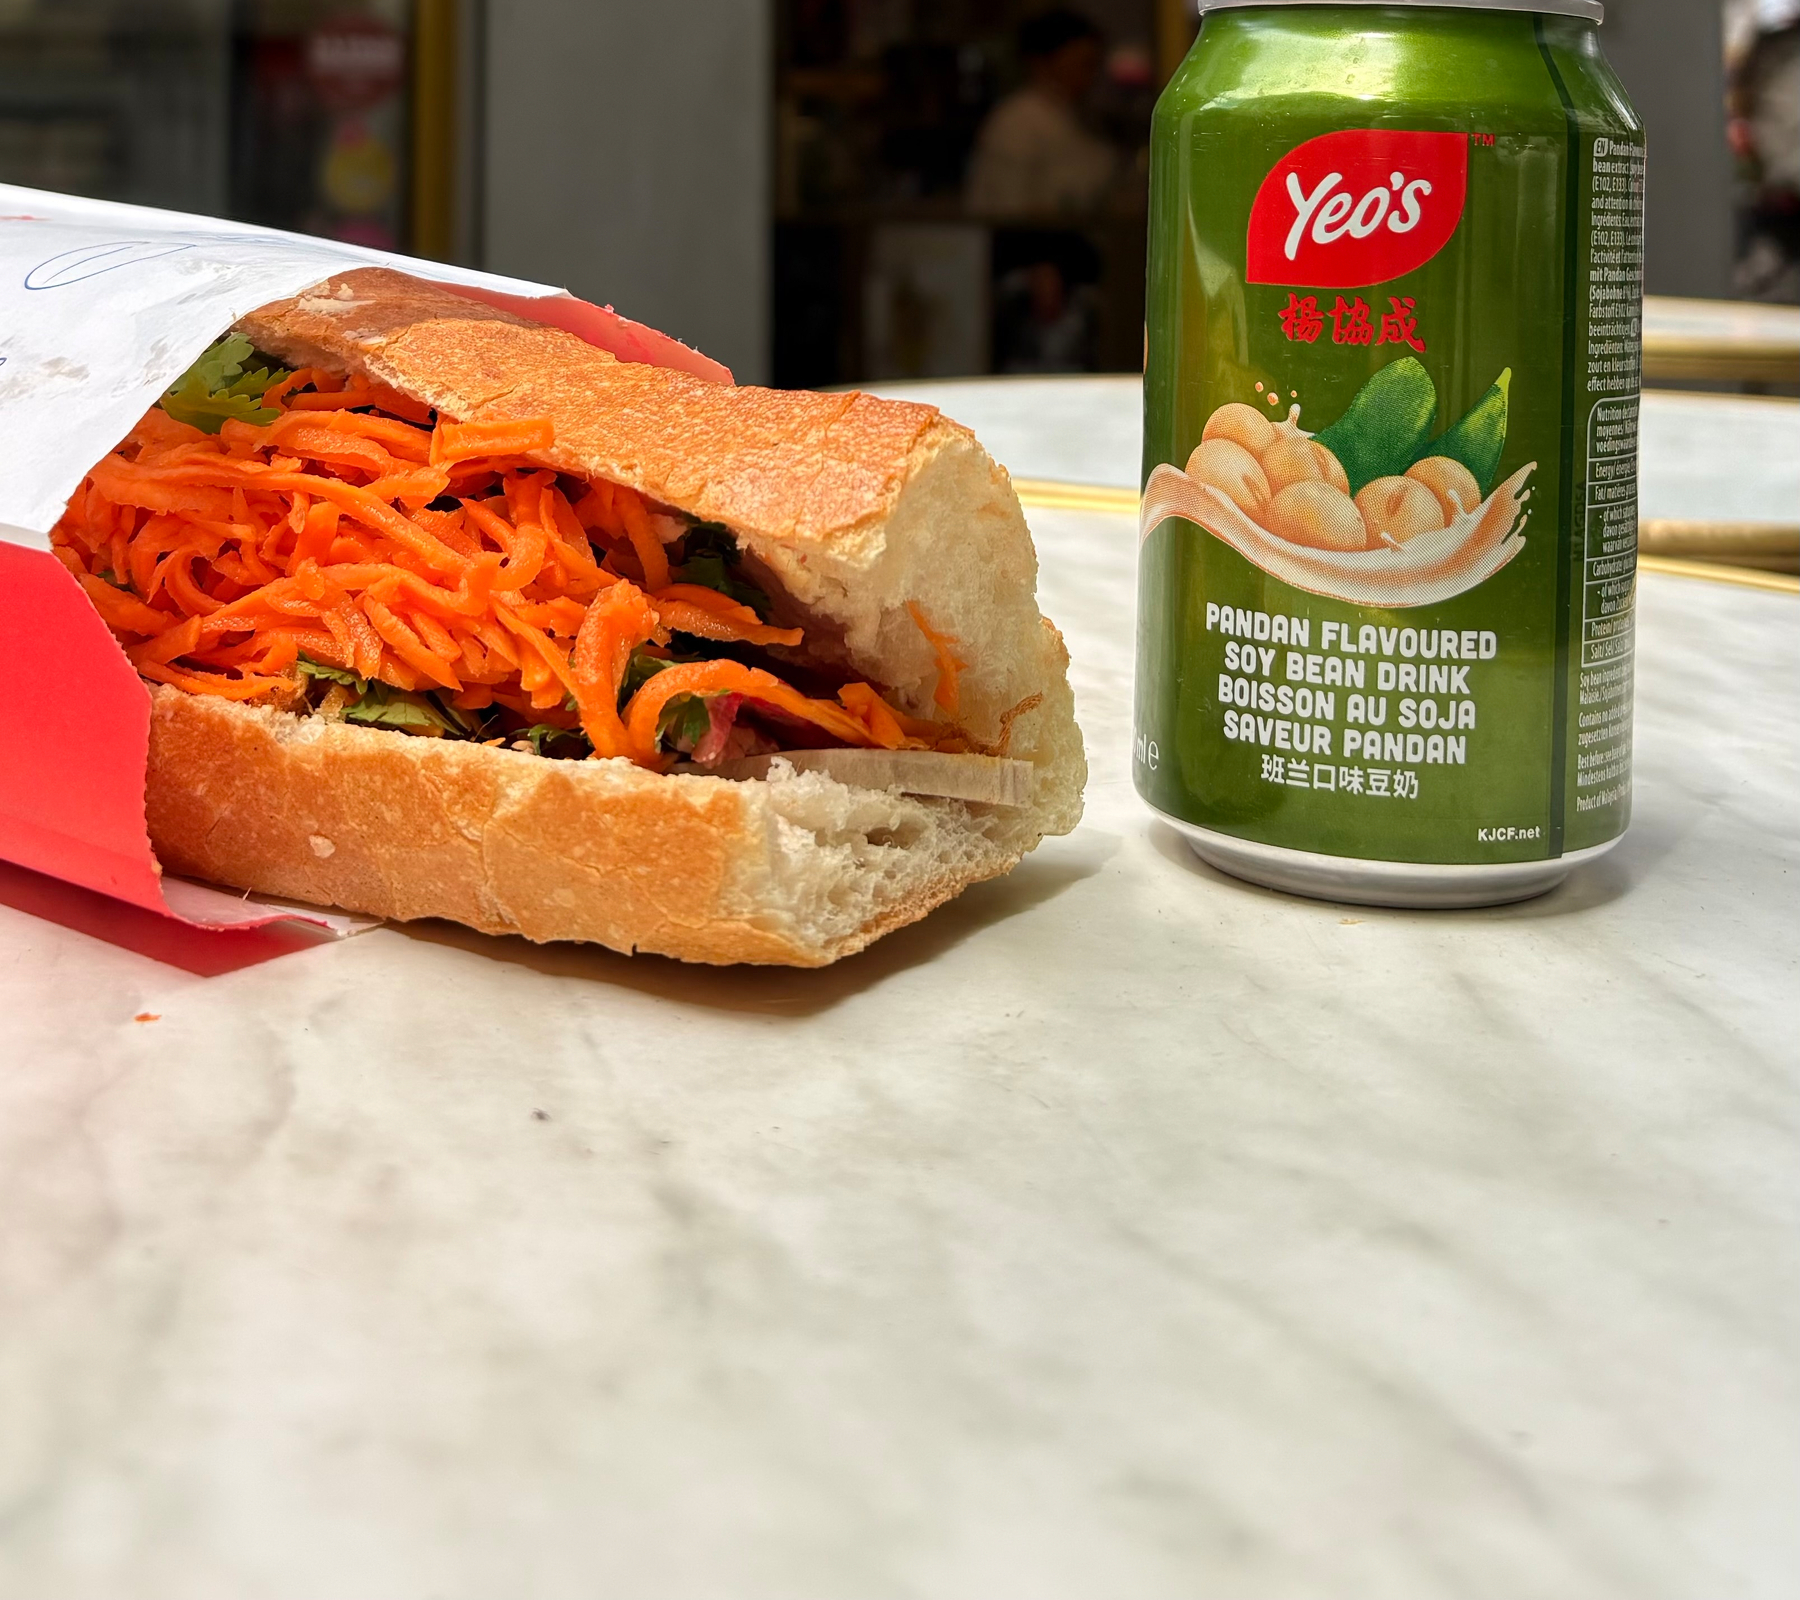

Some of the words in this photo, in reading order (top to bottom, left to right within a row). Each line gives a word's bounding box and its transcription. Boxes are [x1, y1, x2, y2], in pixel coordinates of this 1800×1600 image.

[1609, 140, 1629, 156] Pandan
[1592, 157, 1610, 172] bean
[1591, 194, 1604, 209] and
[1604, 196, 1628, 209] attention
[1284, 171, 1432, 261] Yeo's
[1590, 266, 1603, 281] mit
[1604, 266, 1625, 282] Pandan
[1589, 303, 1615, 318] Farbstoff
[1277, 292, 1427, 353] 楊協成
[1587, 360, 1603, 373] zout
[1603, 361, 1611, 372] en
[1586, 375, 1606, 391] effect
[1596, 406, 1621, 421] Nutrition
[1609, 505, 1622, 520] which
[1603, 523, 1617, 537] davon
[1601, 599, 1615, 614] davon
[1206, 602, 1309, 647] PANDAN
[1321, 621, 1497, 660] FLAVOURED
[1224, 640, 1276, 676] SOY
[1286, 651, 1365, 689] BEAN
[1377, 661, 1470, 694] DRINK
[1580, 672, 1589, 690] Soy
[1590, 670, 1601, 686] bean
[1218, 673, 1334, 720] BOISSON
[1347, 693, 1387, 726] AU
[1398, 698, 1476, 729] SOJA
[1579, 710, 1601, 727] Contains
[1223, 709, 1332, 755] SAVEUR
[1343, 728, 1466, 764] PANDAN
[1577, 753, 1589, 769] Best
[1261, 754, 1419, 800] 班兰口味豆奶
[1576, 794, 1596, 812] Product
[1477, 825, 1540, 841] KJCF.net
